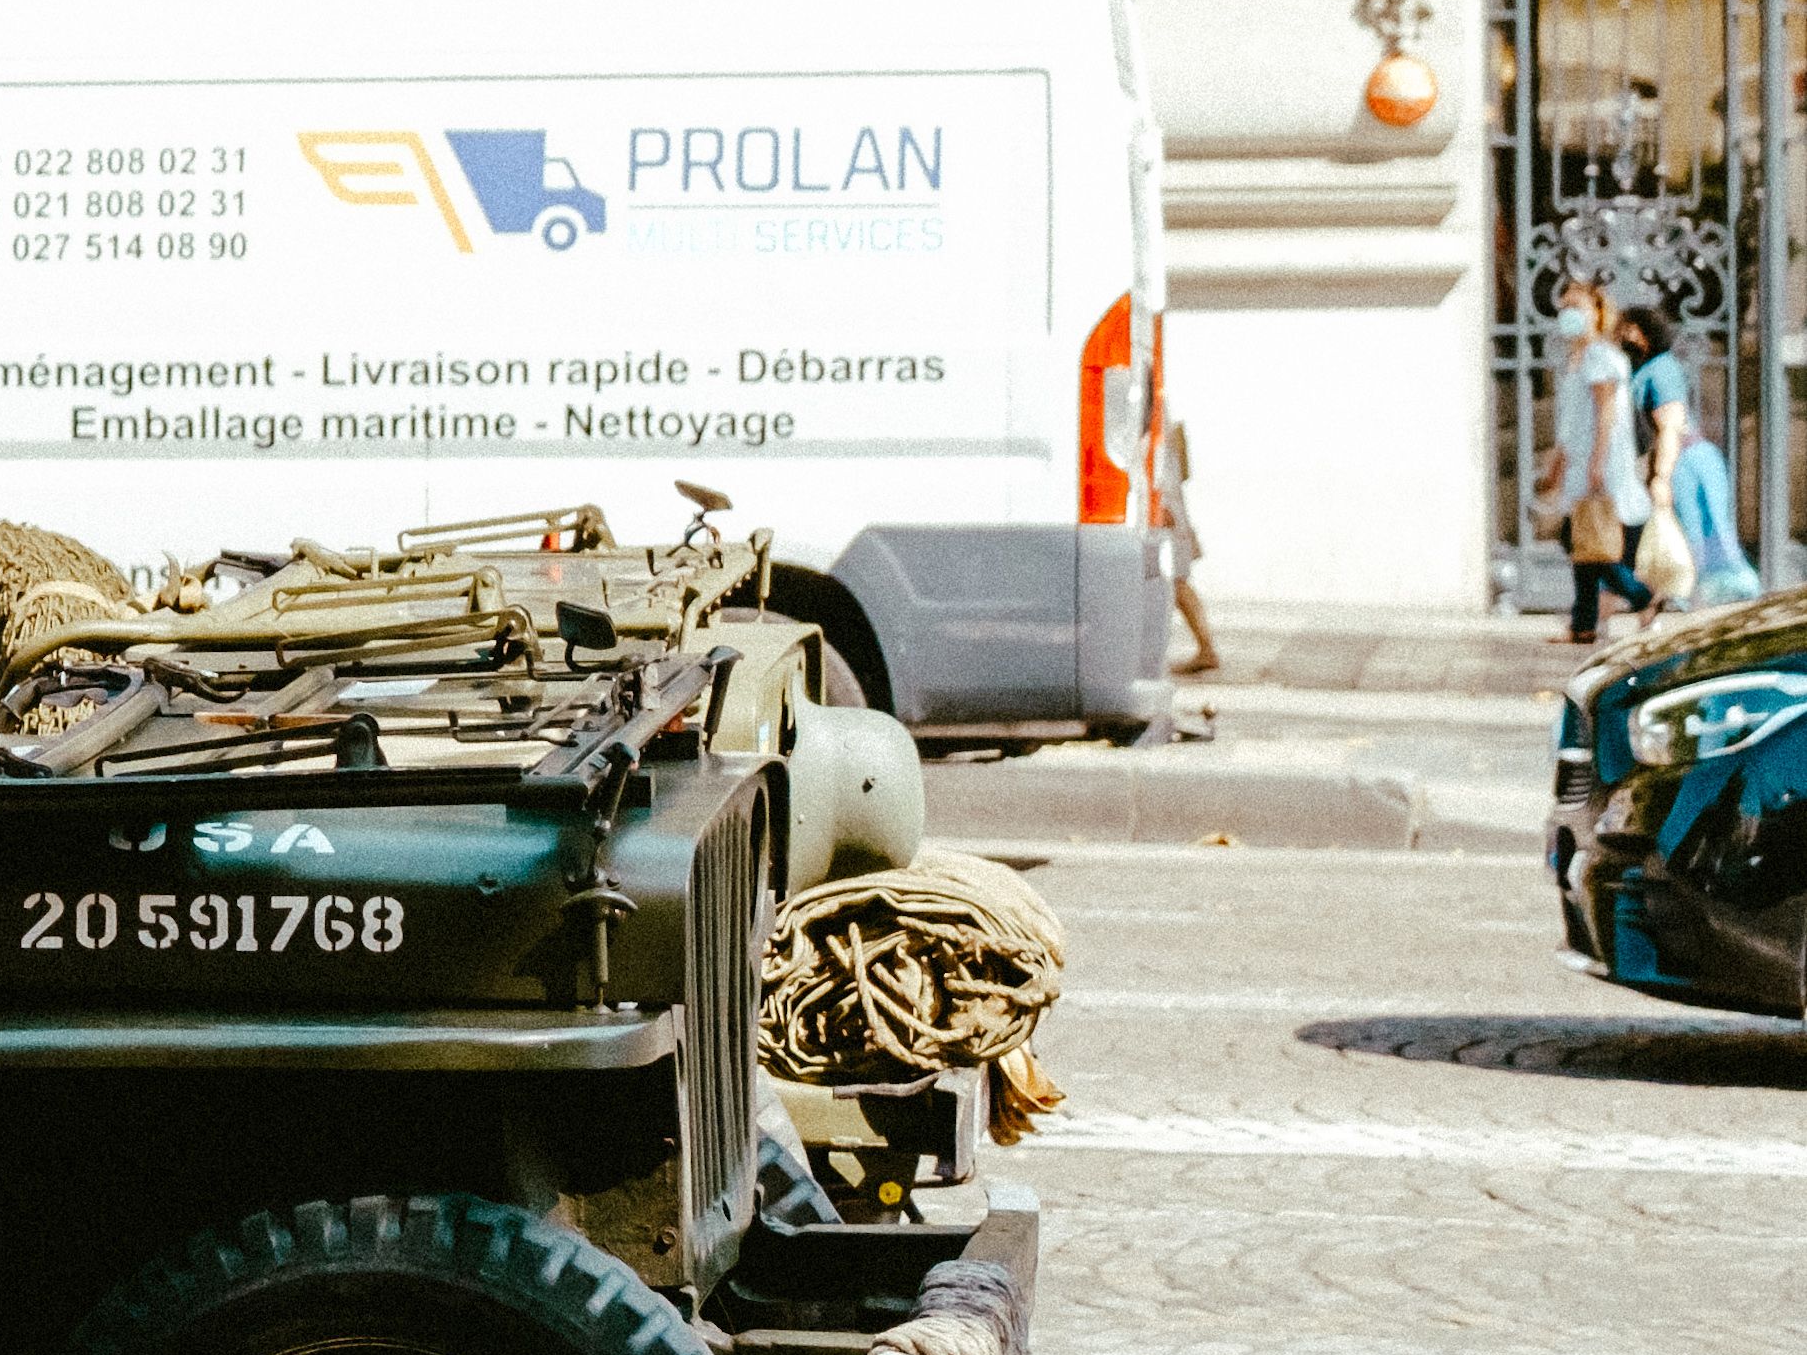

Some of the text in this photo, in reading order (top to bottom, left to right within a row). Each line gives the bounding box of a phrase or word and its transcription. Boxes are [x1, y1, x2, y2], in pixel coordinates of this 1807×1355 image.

[13, 148, 72, 176] 022
[86, 147, 145, 175] 808
[158, 147, 196, 175] 02
[211, 146, 245, 174] 31
[628, 125, 942, 192] PROLAN
[13, 191, 69, 219] 021
[86, 190, 144, 218] 808
[157, 190, 195, 218] 02
[211, 189, 244, 217] 31
[12, 233, 70, 261] 027
[85, 233, 144, 261] 514
[157, 232, 195, 260] 08
[209, 232, 247, 260] 90
[754, 216, 944, 253] SERVICES
[322, 351, 529, 387] Livraison
[548, 351, 689, 392] rapide
[738, 349, 945, 384] Débarras
[71, 405, 304, 448] Emballage
[322, 405, 517, 440] maritime
[565, 404, 796, 446] Nettoyage
